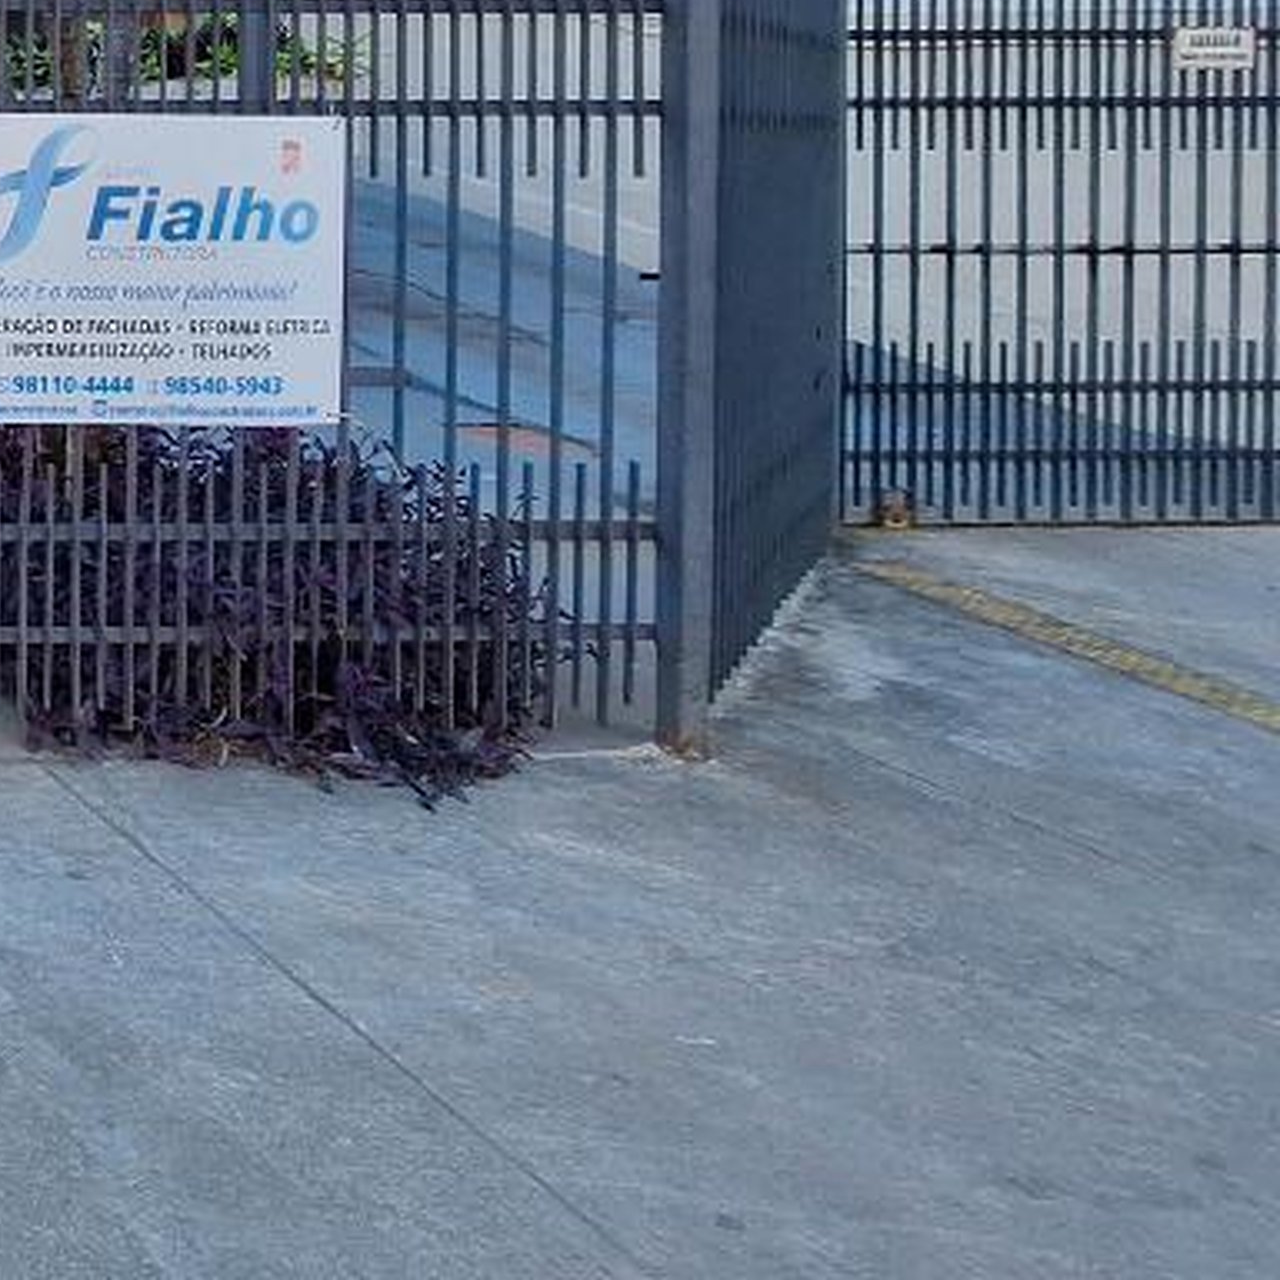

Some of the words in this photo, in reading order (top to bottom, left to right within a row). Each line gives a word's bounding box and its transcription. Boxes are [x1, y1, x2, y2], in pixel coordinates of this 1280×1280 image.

[86, 185, 320, 243] Fialho
[62, 318, 83, 334] DE
[86, 318, 171, 335] FACHADAS
[190, 318, 261, 335] REFORMA
[5, 340, 174, 363] IMPERMEABILIZAÇÃO
[191, 341, 273, 361] TELHADOS
[11, 375, 135, 395] 98110-4444
[164, 375, 285, 396] 98540-5943
